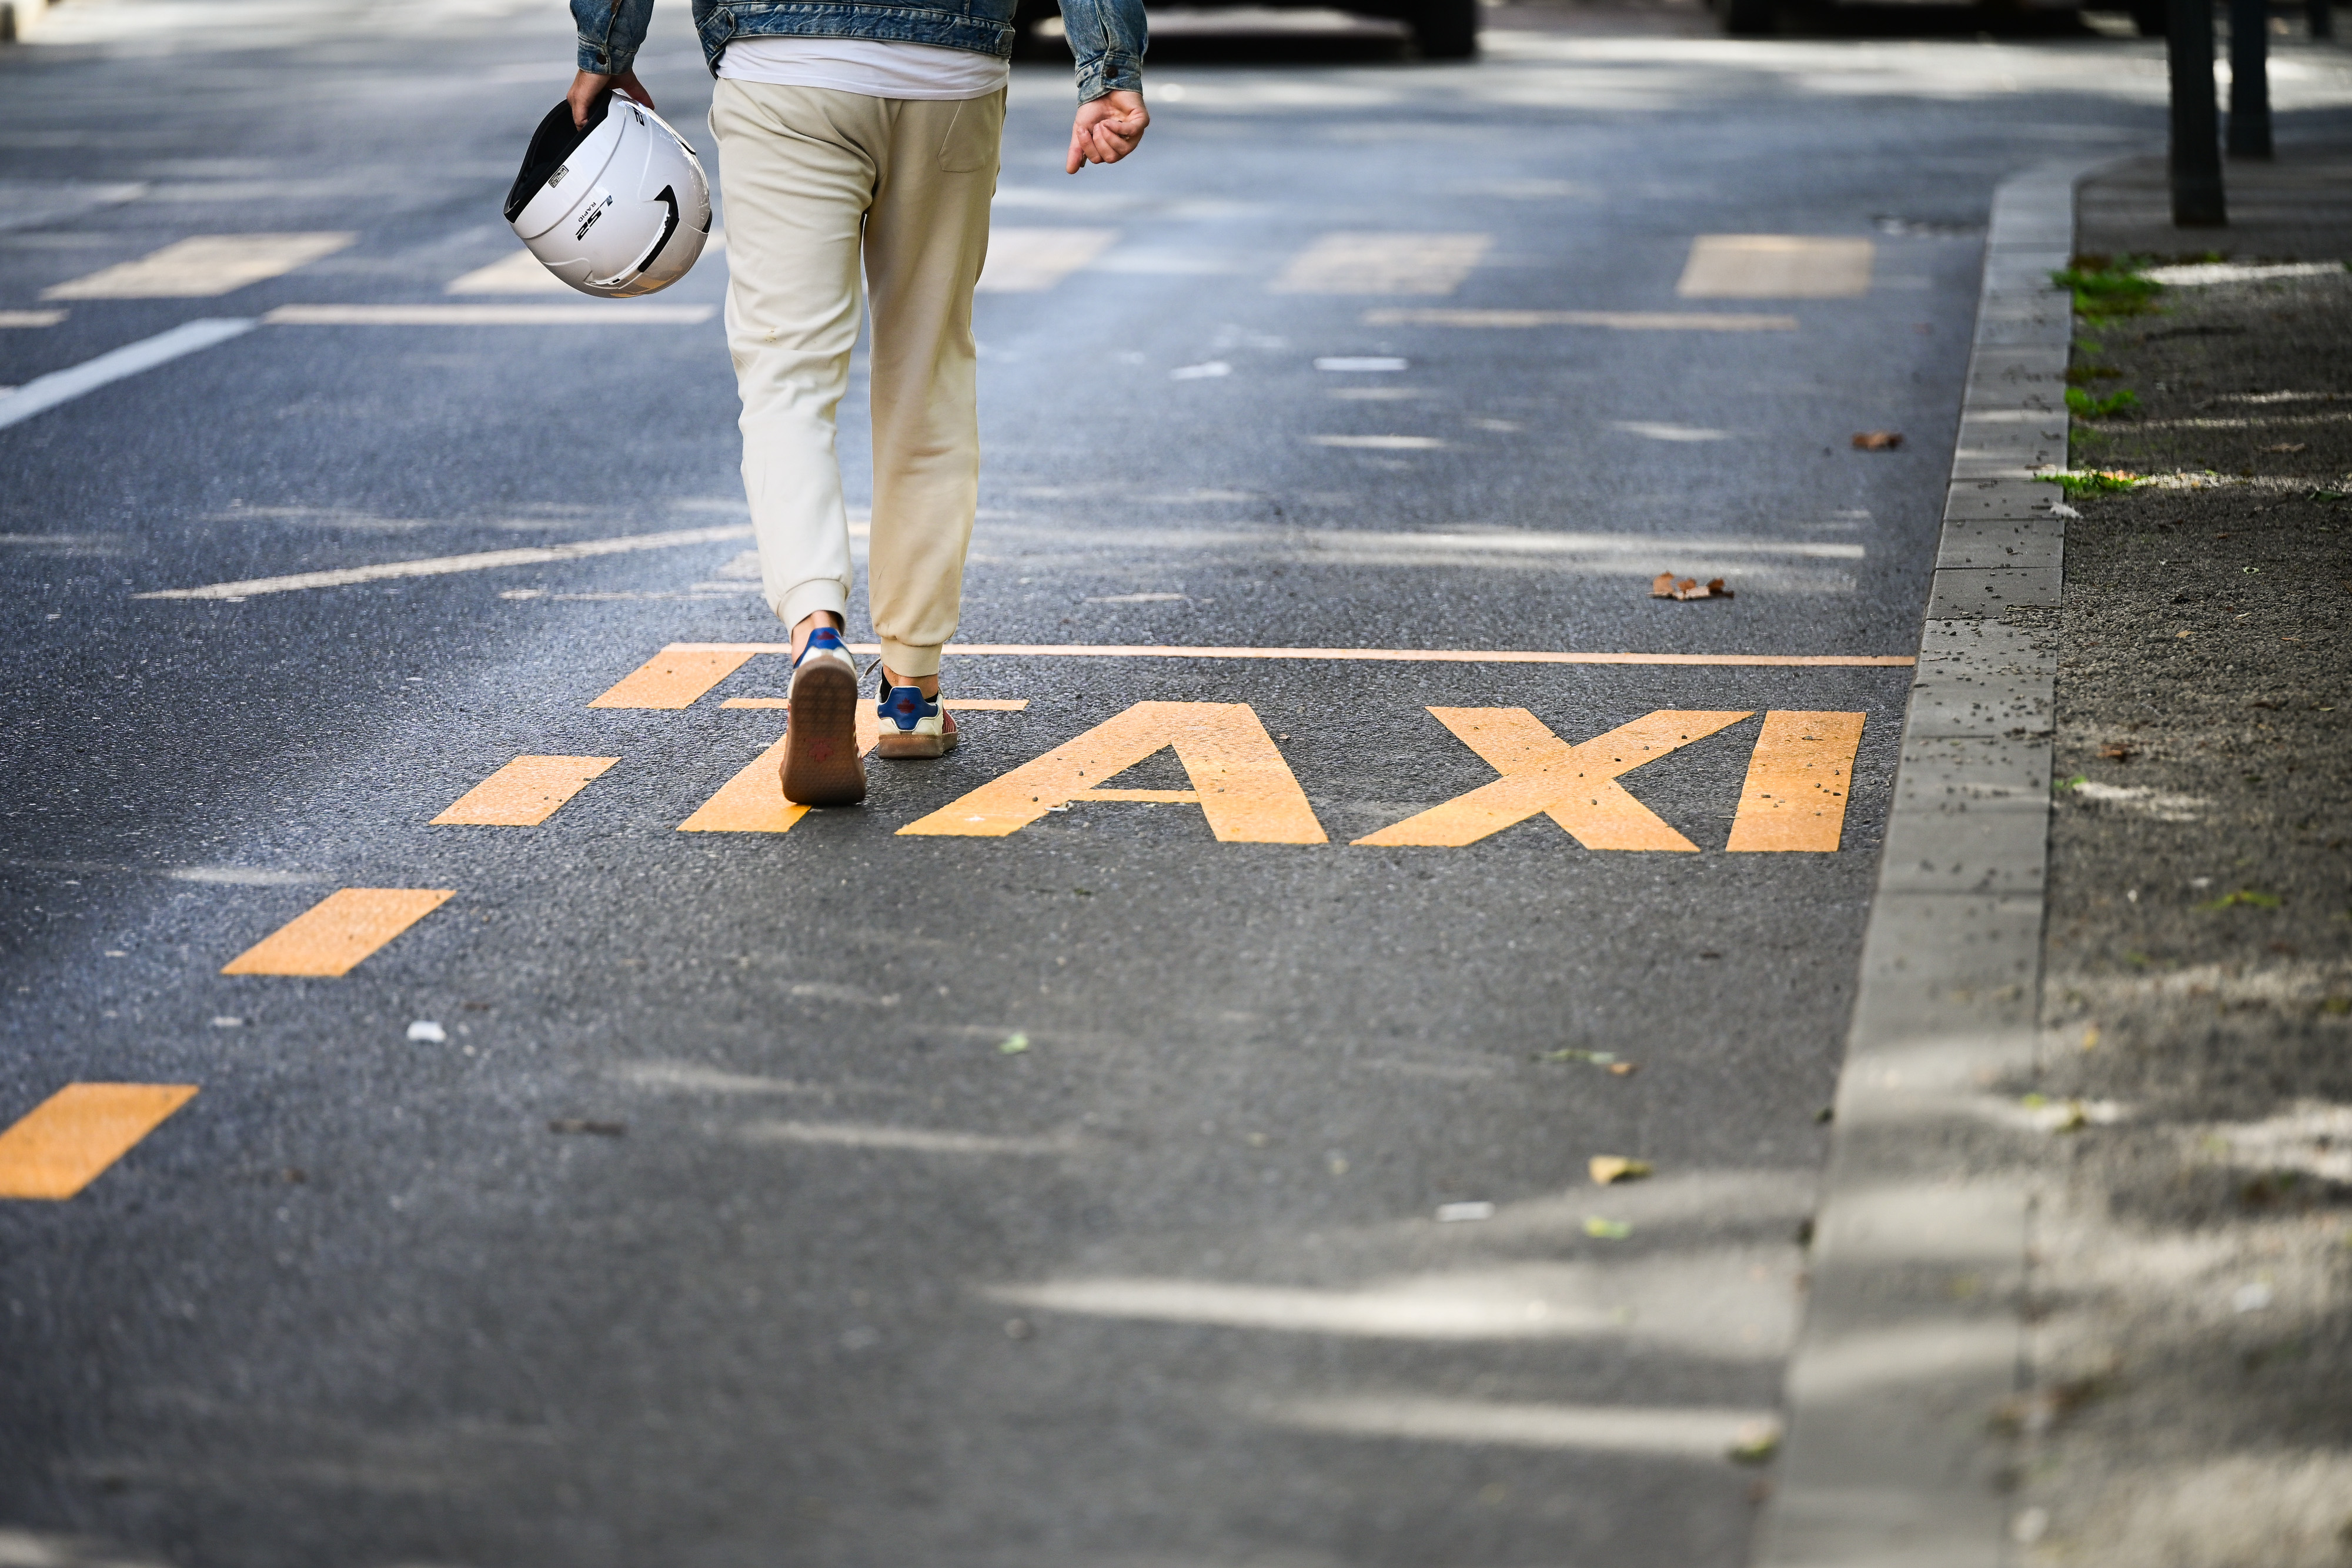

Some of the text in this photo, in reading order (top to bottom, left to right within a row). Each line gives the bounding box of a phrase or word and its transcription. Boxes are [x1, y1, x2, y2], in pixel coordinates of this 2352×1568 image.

[576, 195, 613, 241] LS2
[578, 202, 596, 222] RAPID
[676, 697, 1866, 852] TAXI
